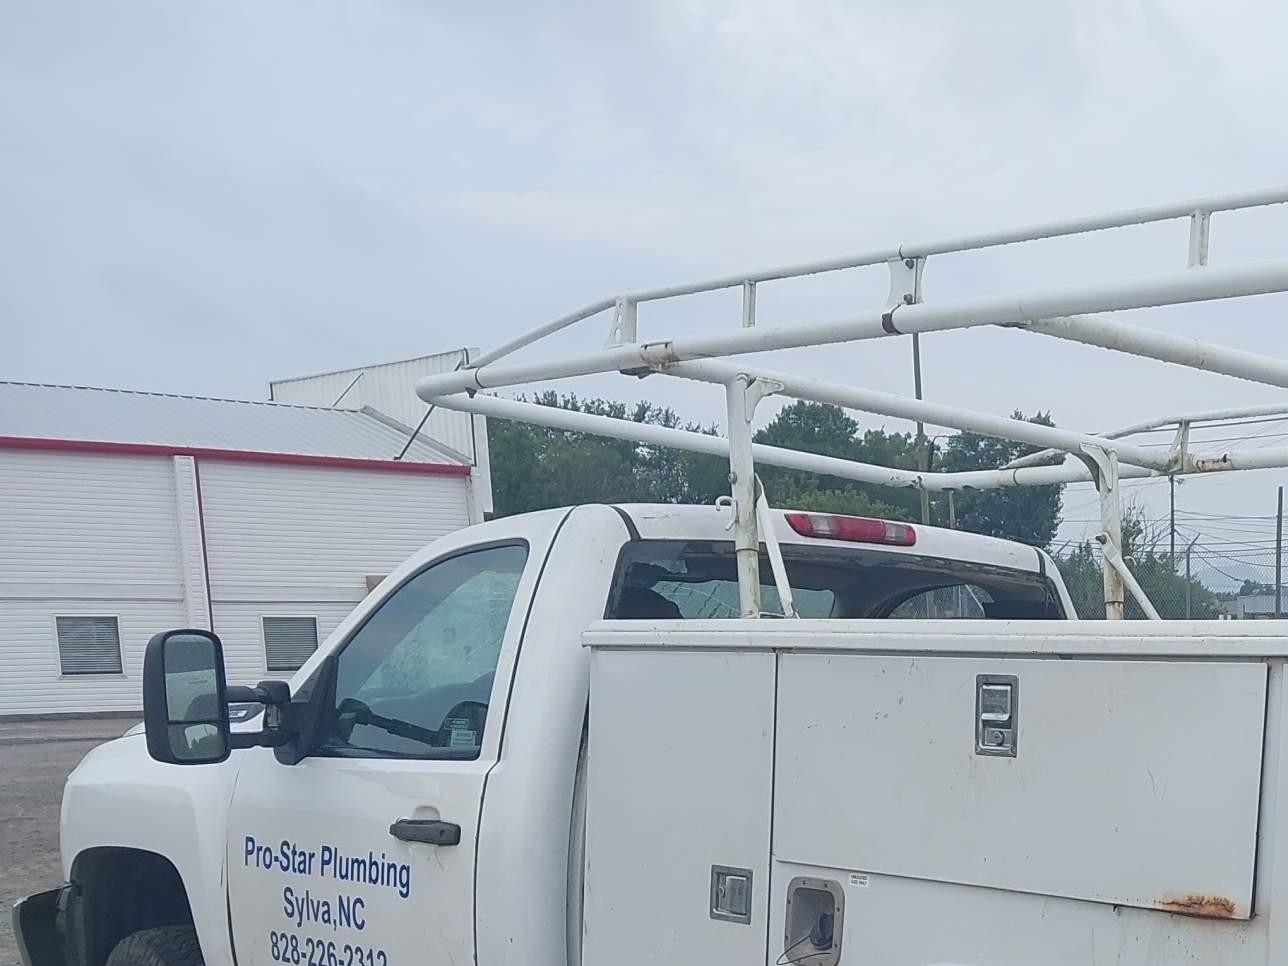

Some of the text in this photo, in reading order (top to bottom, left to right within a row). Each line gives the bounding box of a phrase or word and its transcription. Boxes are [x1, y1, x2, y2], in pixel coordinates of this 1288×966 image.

[244, 836, 411, 898] Pro-Star Plumbing
[283, 886, 366, 931] Sylva,NC
